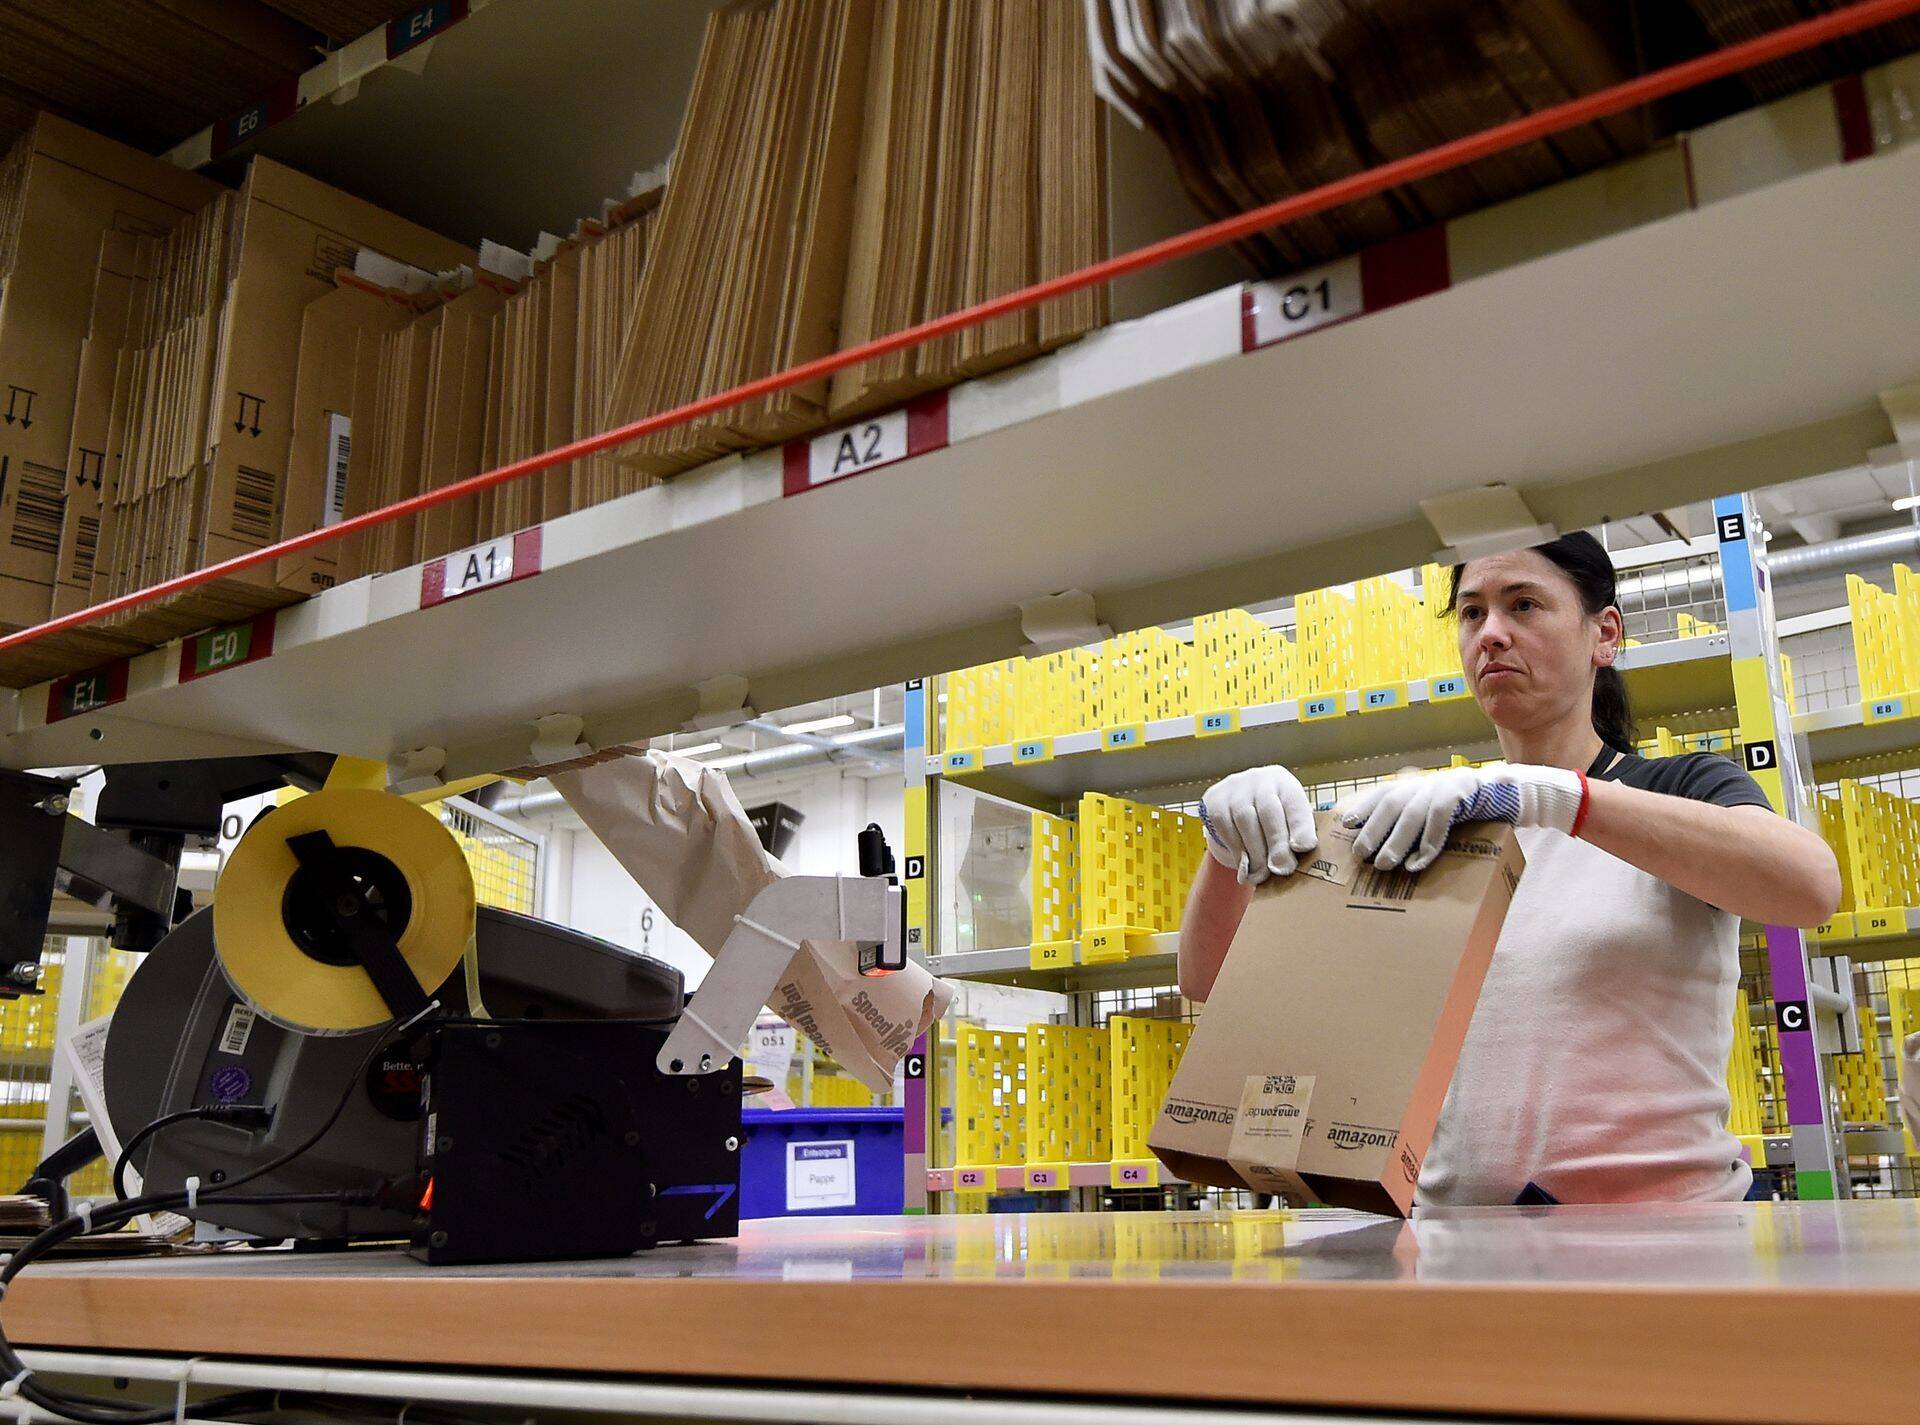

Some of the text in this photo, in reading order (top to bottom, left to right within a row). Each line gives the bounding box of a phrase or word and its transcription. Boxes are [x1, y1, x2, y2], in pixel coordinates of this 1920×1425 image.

[410, 8, 433, 38] E4
[238, 109, 259, 136] E6
[1282, 279, 1330, 320] C1
[832, 423, 882, 474] A2
[1723, 518, 1741, 539] E
[461, 546, 496, 588] A1
[1438, 682, 1455, 693] E8
[73, 677, 96, 711] E1
[1370, 693, 1386, 704] E7
[1310, 703, 1325, 714] E6
[1876, 704, 1893, 714] E8
[1207, 718, 1222, 728] E5
[1113, 733, 1127, 743] E4
[1022, 746, 1035, 756] E3
[1751, 746, 1770, 767] D
[951, 757, 965, 766] E2
[908, 860, 921, 877] D
[641, 907, 653, 931] 6
[1871, 918, 1887, 928] D8
[1817, 925, 1832, 935] D7
[1093, 937, 1107, 947] D5
[1043, 949, 1057, 959] D2
[1782, 1005, 1802, 1028] C
[762, 1036, 785, 1047] 051
[908, 1058, 921, 1076] C
[1165, 1103, 1234, 1125] amazon.de
[1327, 1127, 1398, 1150] amazon.it
[962, 1174, 976, 1183] C2
[1033, 1173, 1047, 1183] C3
[1123, 1169, 1138, 1180] C4
